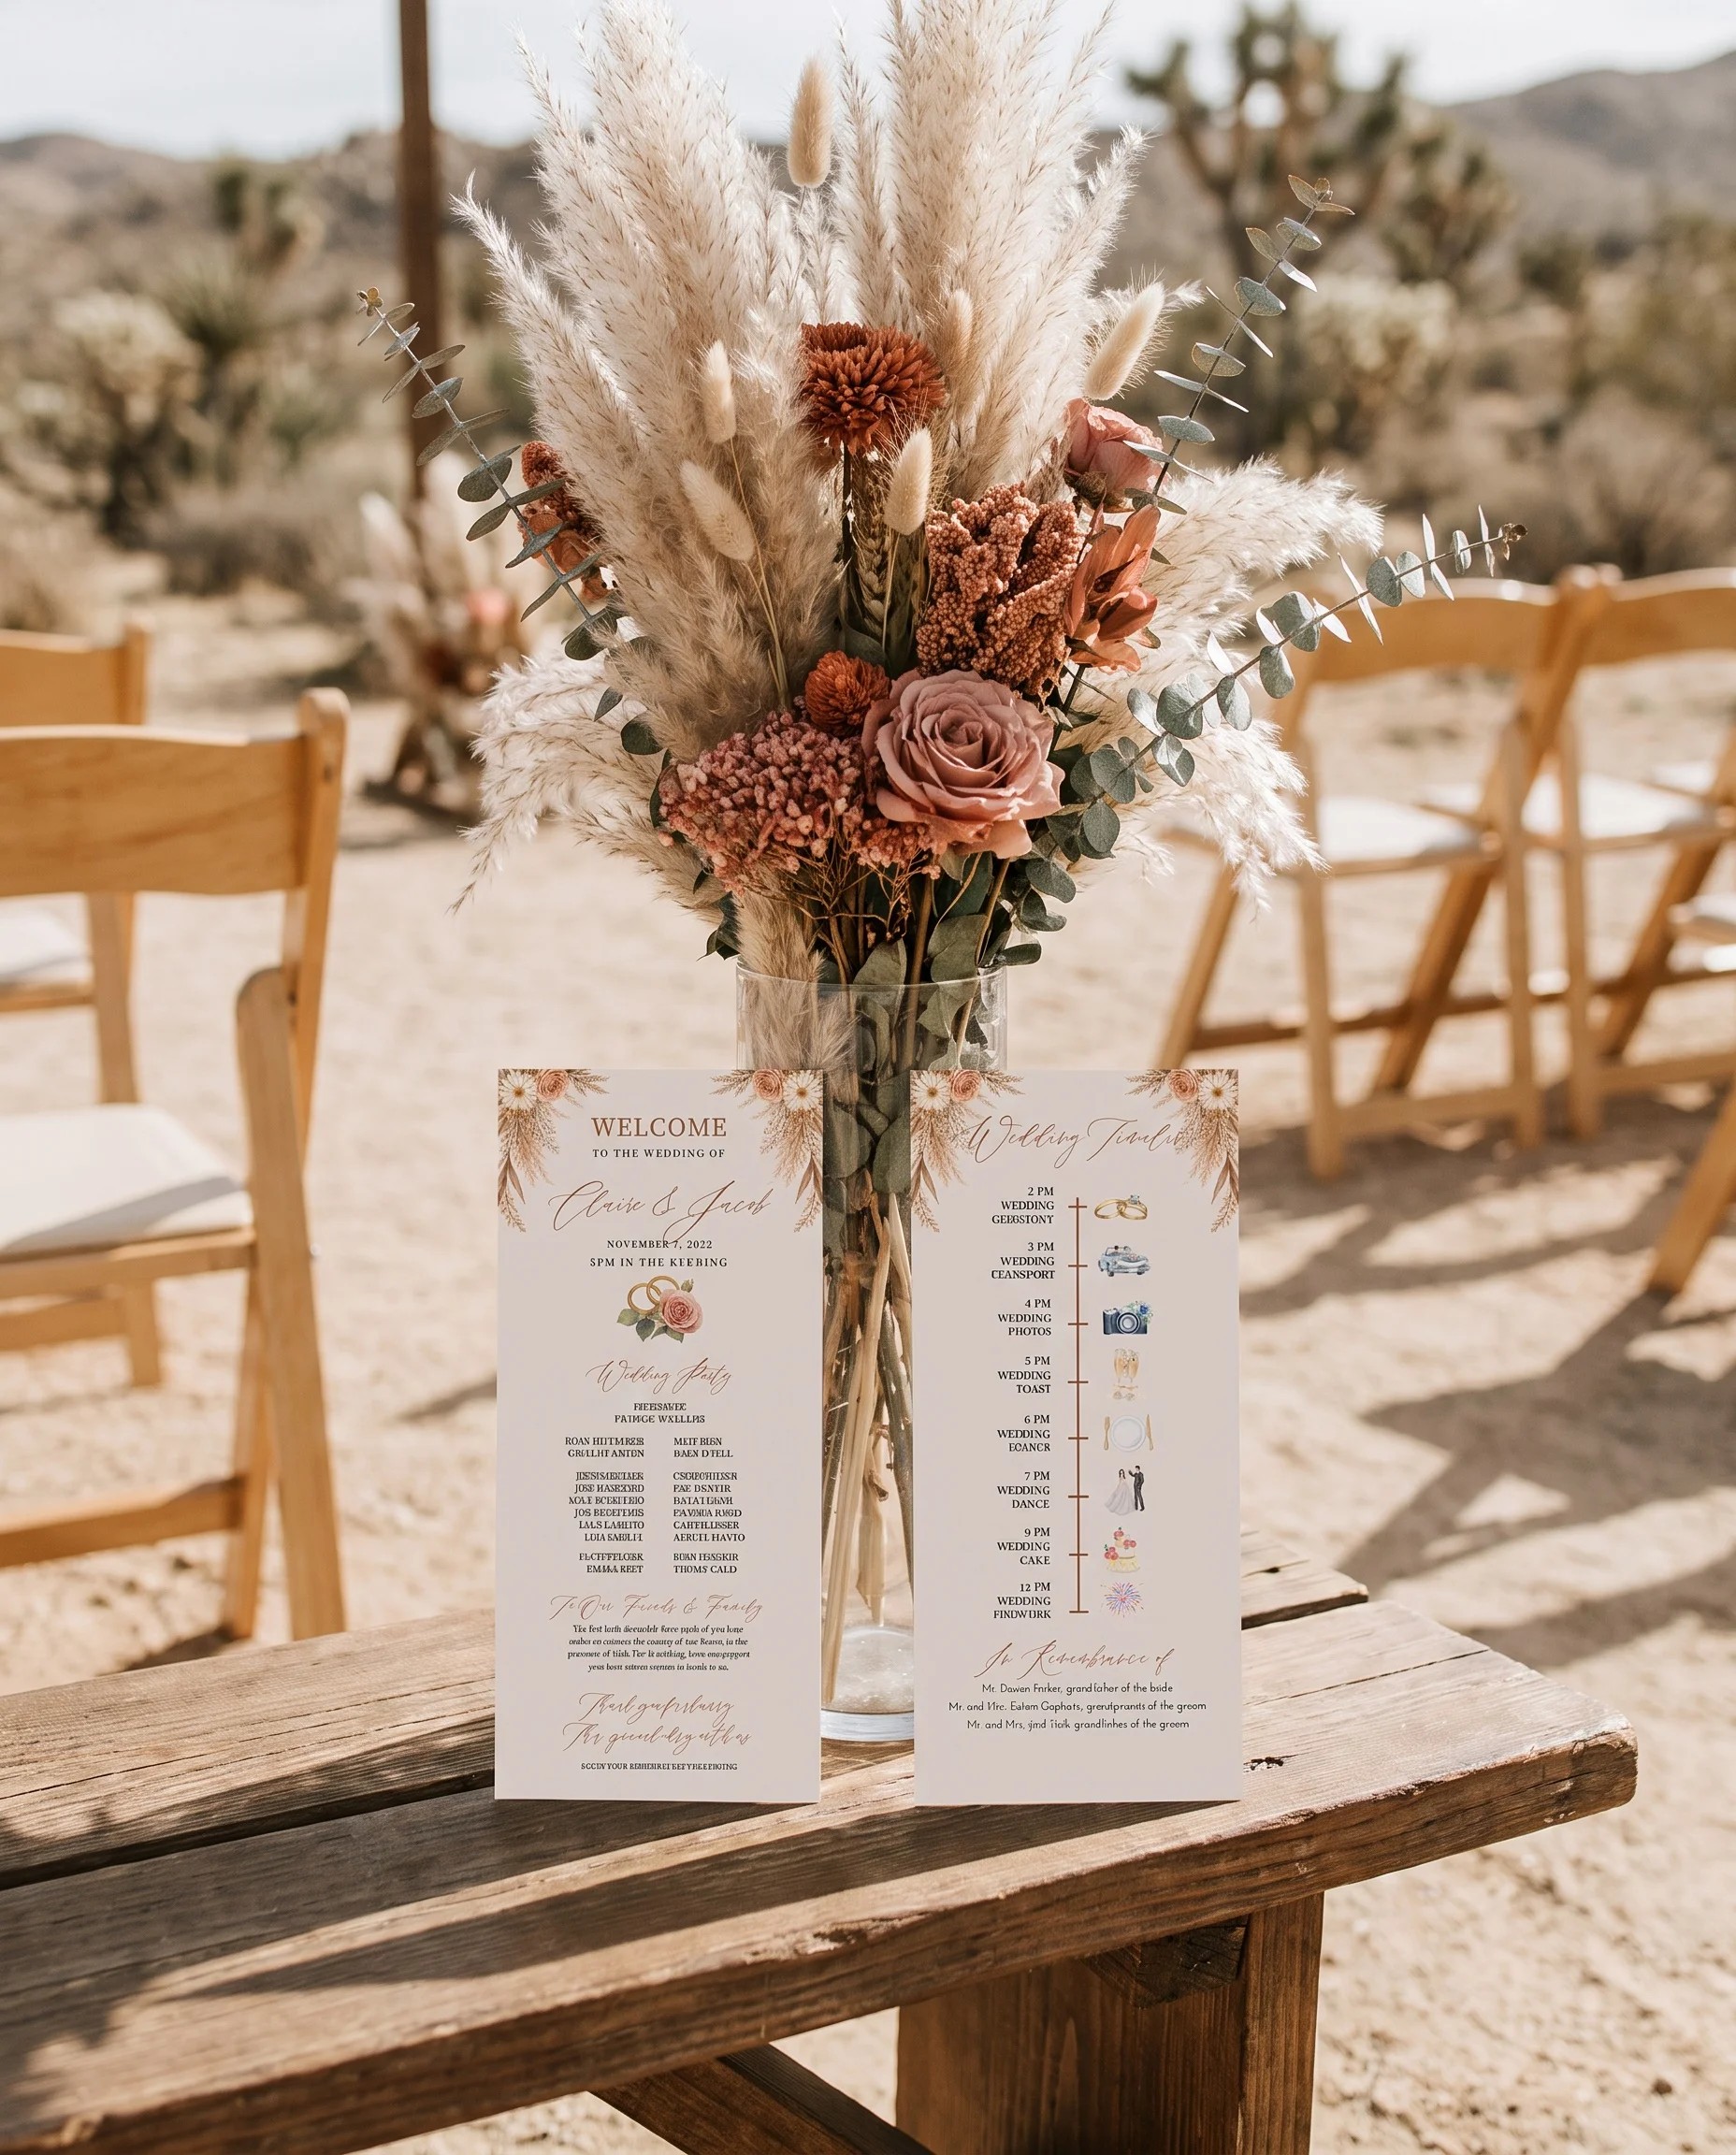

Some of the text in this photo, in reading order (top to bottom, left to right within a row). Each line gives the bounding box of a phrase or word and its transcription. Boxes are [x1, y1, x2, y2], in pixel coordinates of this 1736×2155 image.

[591, 1117, 727, 1137] WELCOME
[954, 1115, 1085, 1168] Wedding
[593, 1149, 725, 1158] TO THE WEDDING OF
[1028, 1187, 1054, 1195] 2 PM
[1001, 1201, 1054, 1210] WEDDING
[548, 1180, 774, 1245] Claire & Jacob
[607, 1240, 670, 1249] NOVEMBER
[687, 1240, 712, 1249] 2022
[1028, 1242, 1054, 1251] 3 PM
[621, 1258, 634, 1267] IN
[640, 1258, 664, 1267] THE
[1001, 1256, 1054, 1266] WEDDING
[1025, 1299, 1051, 1308] 4 PM
[998, 1314, 1051, 1323] WEDDING
[1008, 1327, 1051, 1336] PHOTOS
[1025, 1356, 1050, 1366] 5 PM
[586, 1358, 733, 1395] Wedding Party
[998, 1371, 1051, 1380] WEDDING
[1017, 1384, 1050, 1394] TOAST
[1024, 1415, 1049, 1425] 6 PM
[997, 1429, 1050, 1439] WEDDING
[1025, 1471, 1049, 1481] 7 PM
[997, 1486, 1050, 1495] WEDDING
[1012, 1500, 1049, 1509] DANCE
[1025, 1527, 1050, 1537] 9 PM
[997, 1542, 1050, 1552] WEDDING
[1020, 1556, 1050, 1565] CAKE
[1034, 1583, 1050, 1591] PM
[997, 1597, 1050, 1606] WEDDING
[1155, 1648, 1175, 1675] of
[982, 1684, 997, 1693] Mr.
[1121, 1683, 1131, 1692] of
[1134, 1683, 1147, 1692] the
[948, 1702, 964, 1711] Mr.
[967, 1701, 984, 1711] and
[1148, 1700, 1157, 1710] of
[1160, 1700, 1173, 1710] the
[967, 1720, 982, 1728] Mr.
[985, 1719, 1002, 1728] and
[1131, 1719, 1139, 1728] of
[1143, 1718, 1156, 1728] the
